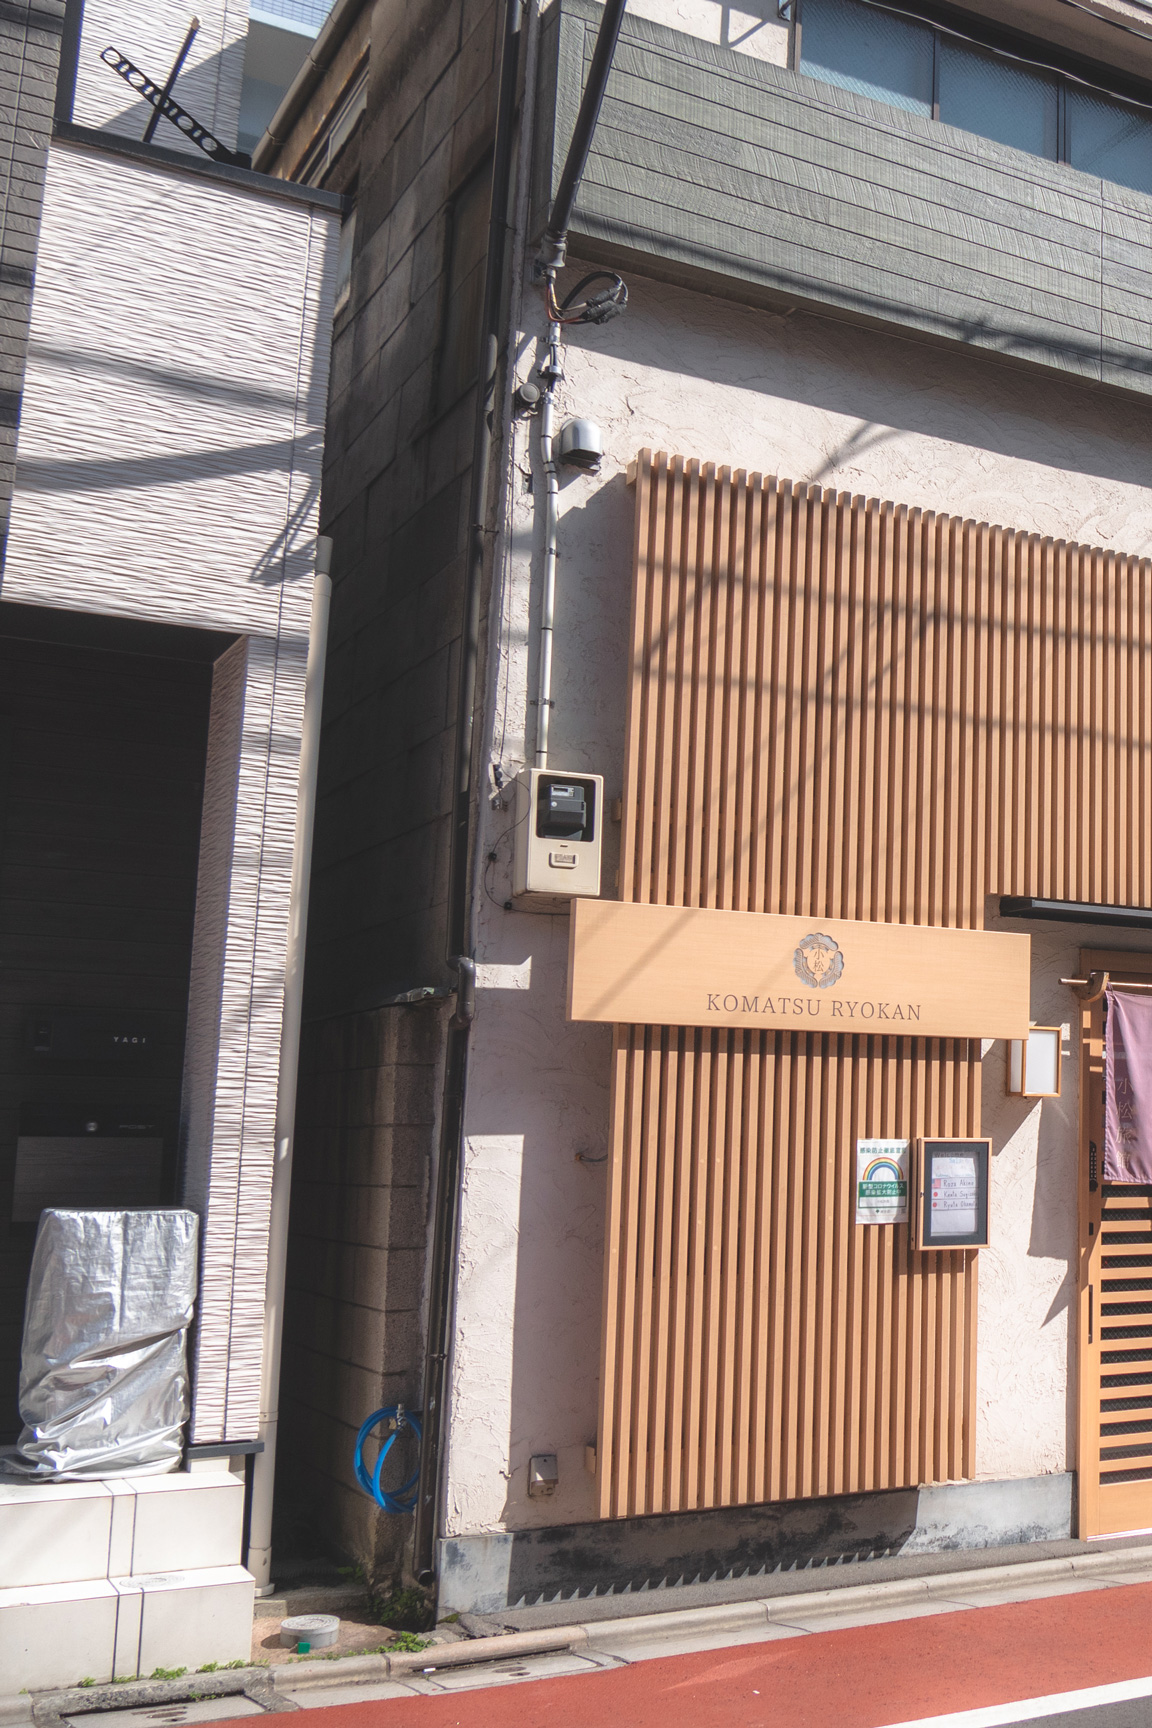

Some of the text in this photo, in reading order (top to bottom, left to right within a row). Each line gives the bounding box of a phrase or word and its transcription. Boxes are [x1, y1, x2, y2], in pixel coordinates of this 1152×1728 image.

[813, 949, 825, 972] 小松
[706, 993, 922, 1021] KOMATSU RYOKAN
[113, 1036, 146, 1044] YAGI
